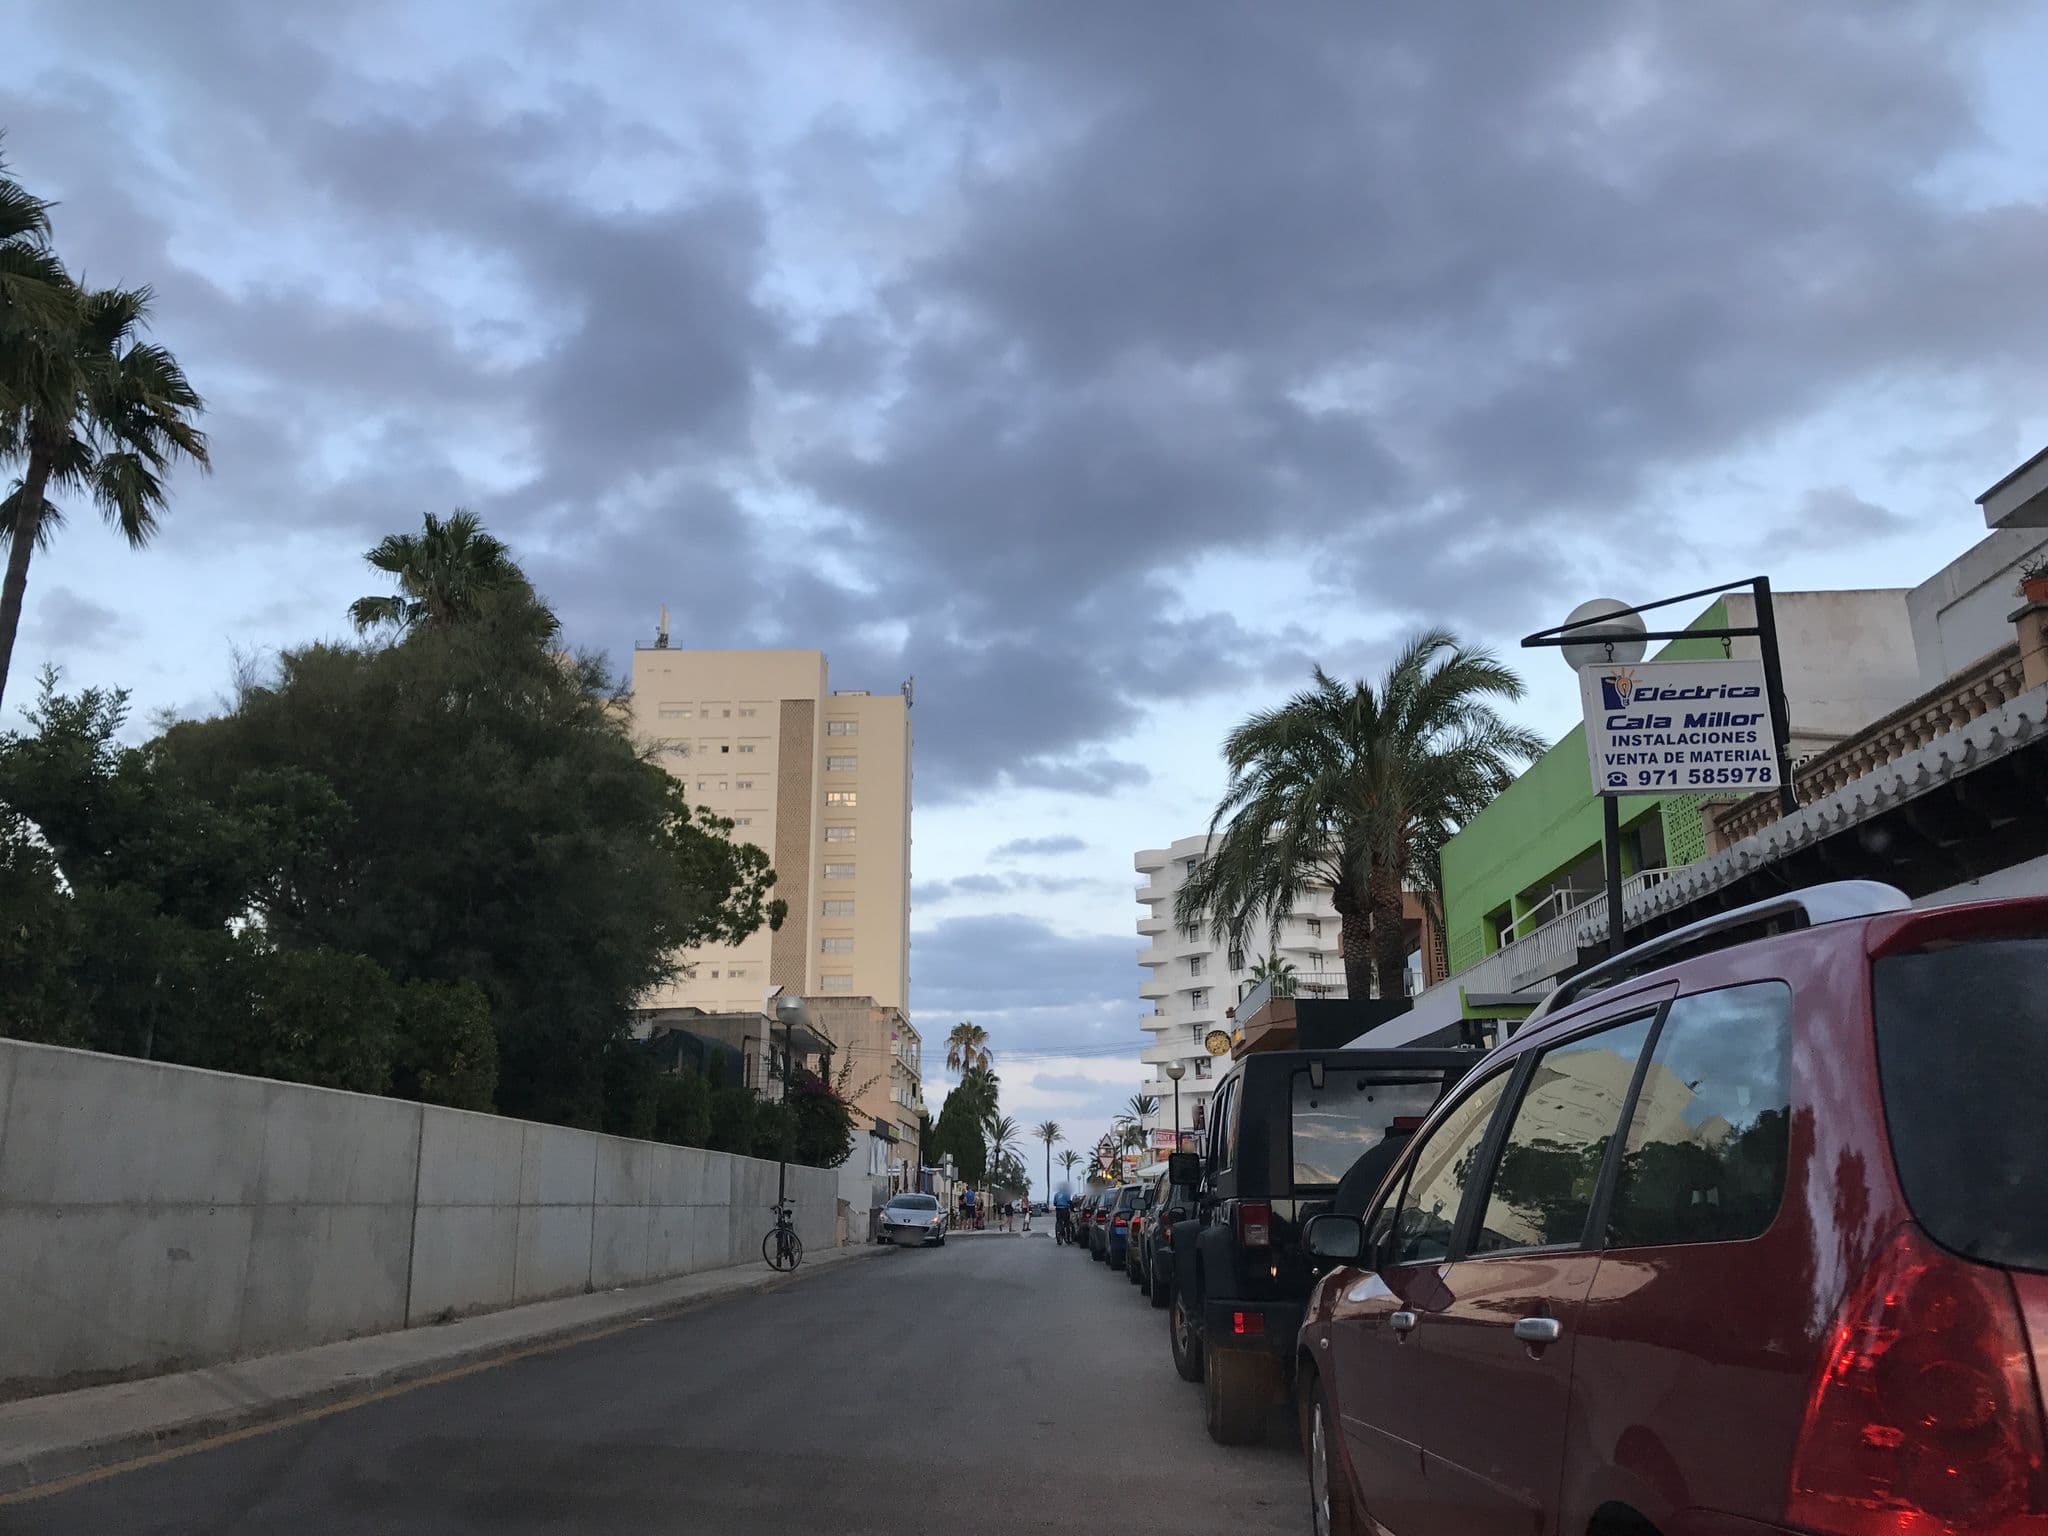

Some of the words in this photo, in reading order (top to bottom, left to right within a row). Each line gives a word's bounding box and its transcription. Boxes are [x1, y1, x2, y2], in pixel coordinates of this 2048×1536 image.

[1633, 683, 1760, 702] Eléctrica
[1606, 714, 1672, 731] Cala
[1683, 712, 1765, 728] Millor
[1612, 731, 1757, 747] INSTALACIONES
[1605, 752, 1658, 765] VENTA
[1664, 751, 1685, 763] DE
[1690, 749, 1771, 763] MATERIAL
[1638, 769, 1678, 785] 971
[1688, 767, 1772, 784] 585978
